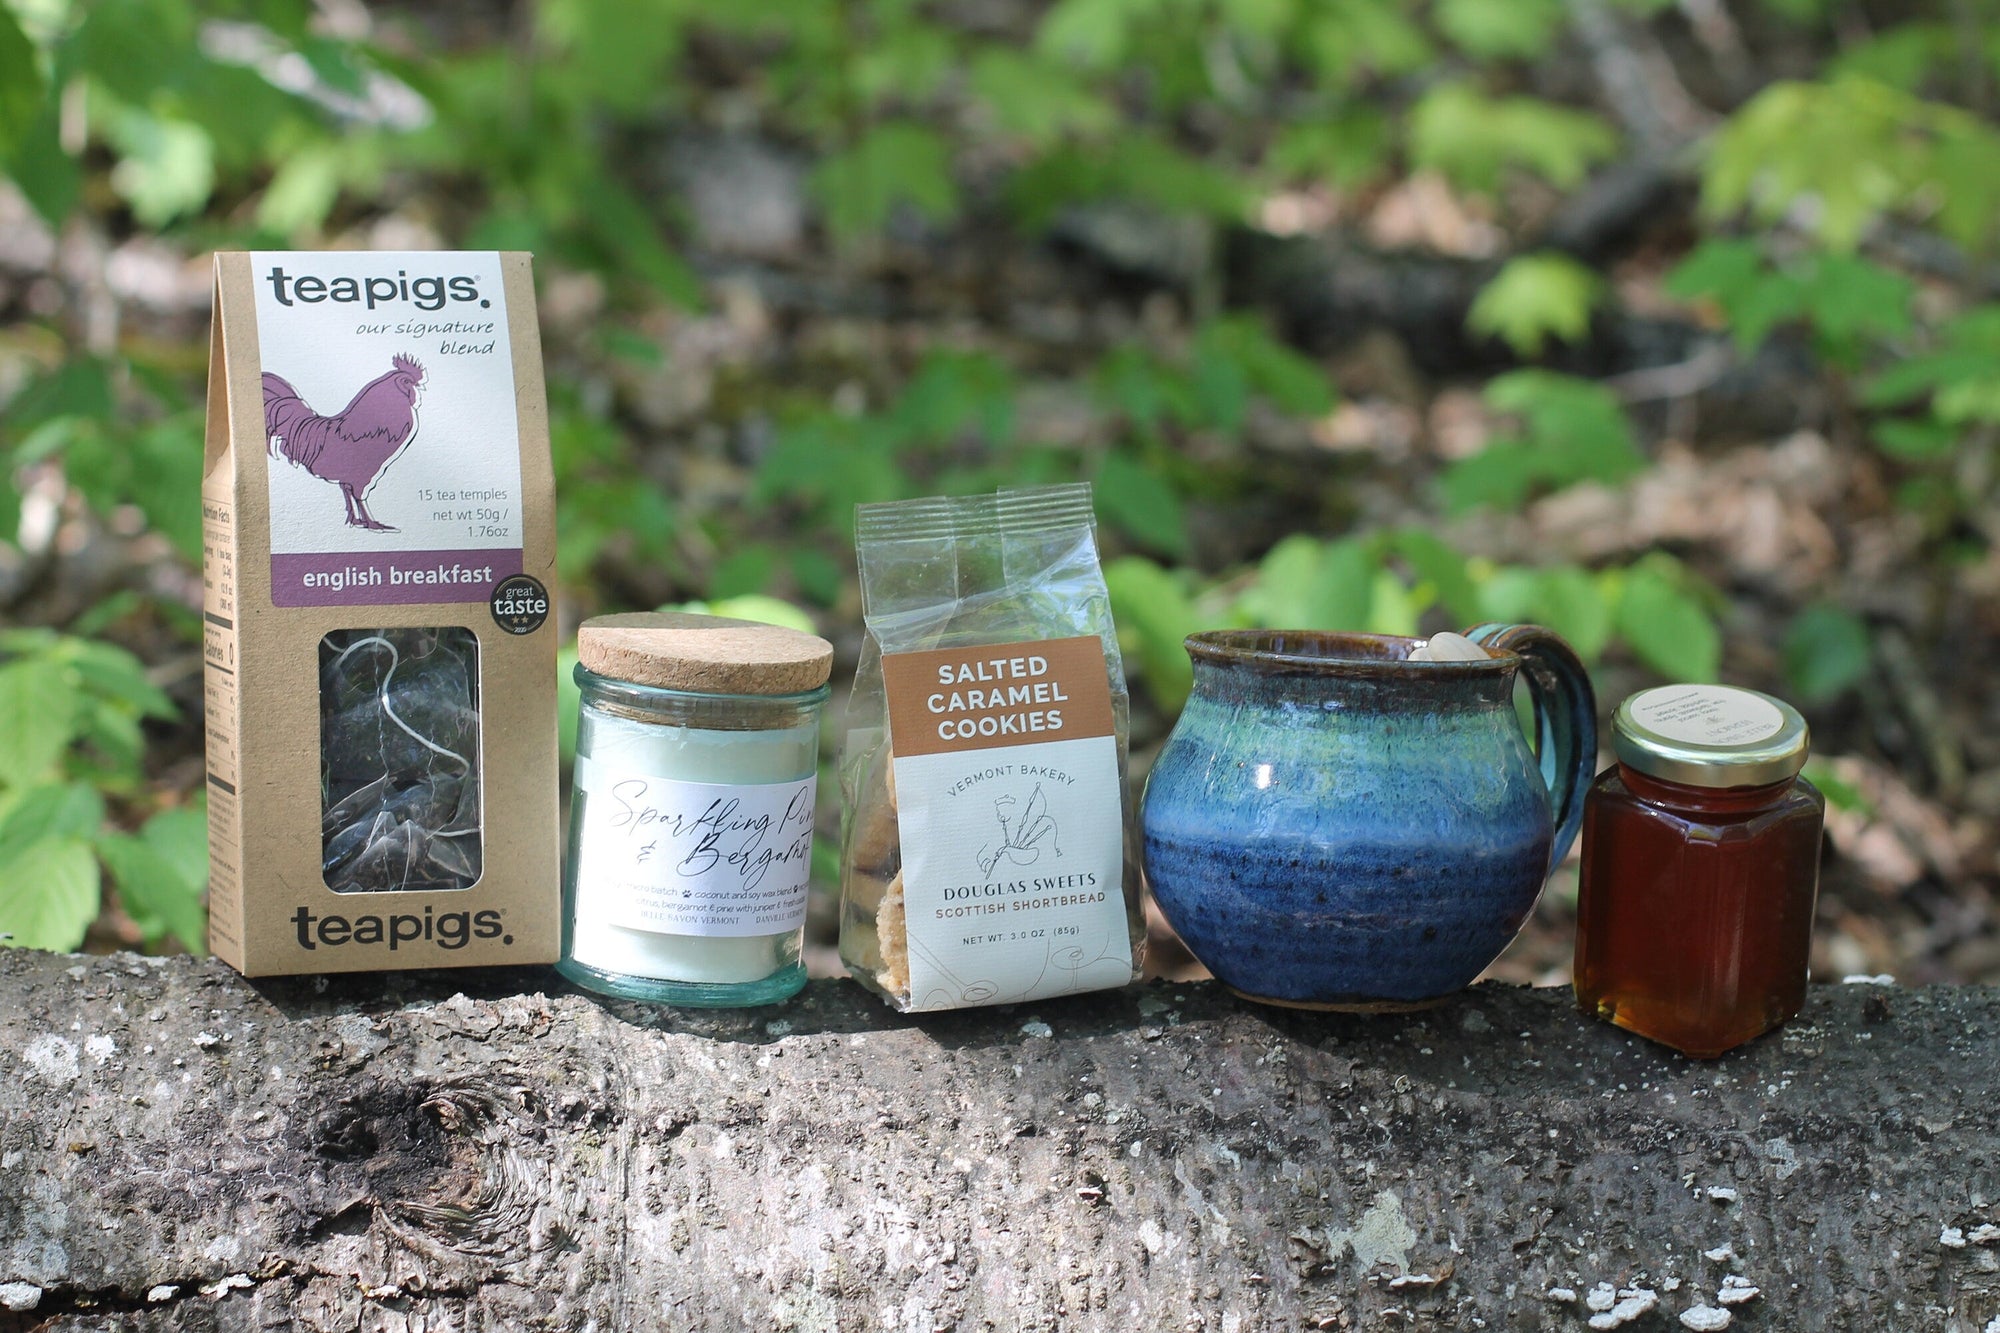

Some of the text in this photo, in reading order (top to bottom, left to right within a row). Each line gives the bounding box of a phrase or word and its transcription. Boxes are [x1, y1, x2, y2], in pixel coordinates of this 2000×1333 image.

[356, 318, 494, 338] our signature
[440, 340, 495, 355] blend
[418, 488, 508, 502] 15 tea temples
[433, 508, 509, 523] net wt 50g /
[468, 525, 509, 537] 1.76oz
[303, 564, 492, 591] english breakfast
[506, 586, 534, 599] great
[494, 598, 546, 614] taste
[938, 656, 1048, 685] SALTED
[927, 682, 1069, 713] CARAMEL
[938, 710, 1063, 740] COOKIES
[947, 765, 1076, 797] VERMONT BAKERY
[609, 779, 814, 838] Sparkling Pin
[651, 886, 678, 896] batch
[694, 890, 730, 899] coconut
[731, 889, 747, 900] and
[747, 891, 761, 900] soy
[944, 872, 1096, 901] DOUGLAS SWEETS
[661, 900, 707, 912] bergamot
[716, 904, 734, 914] pine
[735, 903, 752, 913] with
[752, 903, 776, 914] juniper
[936, 892, 1106, 919] SCOTTISH SHORTBREAD
[701, 916, 740, 925] VERMONT
[963, 925, 1080, 945] NET WT. 3.0 OZ (85g)
